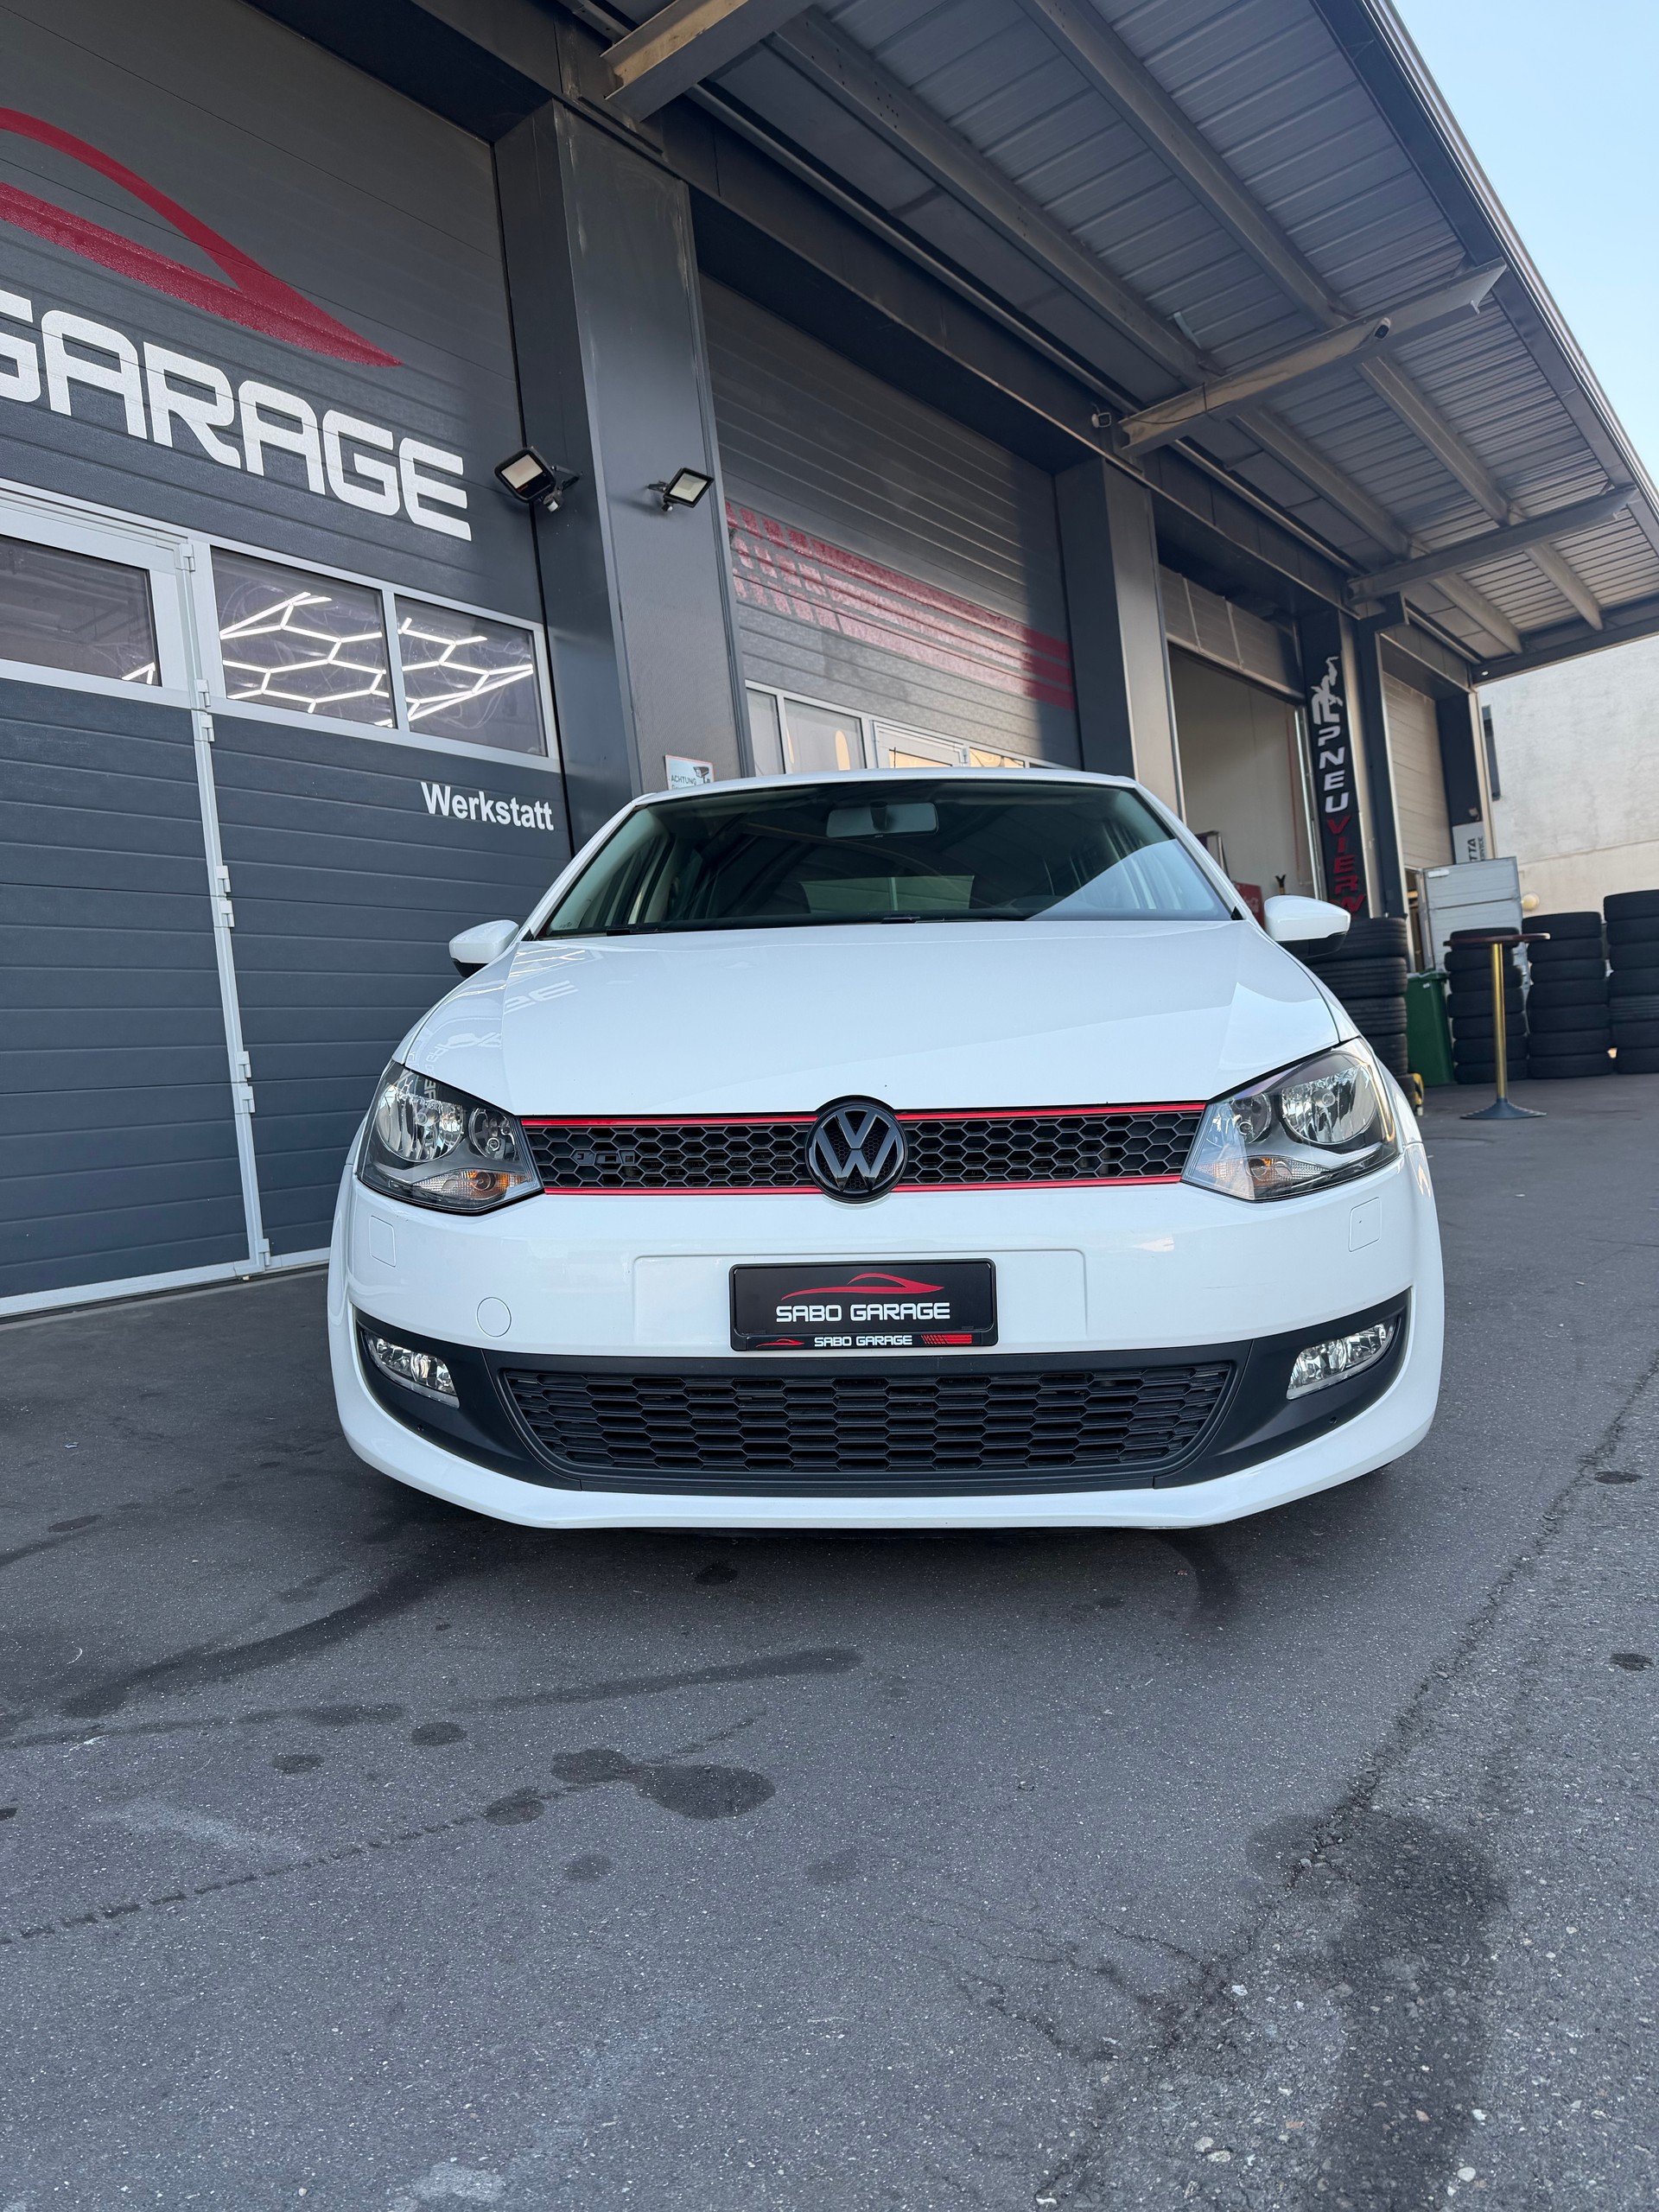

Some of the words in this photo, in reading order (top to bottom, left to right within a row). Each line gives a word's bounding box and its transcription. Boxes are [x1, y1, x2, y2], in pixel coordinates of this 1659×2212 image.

[671, 774, 696, 785] ACHTUNG
[1318, 725, 1349, 814] PNEU
[421, 781, 554, 830] Werkstatt
[776, 1305, 842, 1323] SABO
[849, 1302, 950, 1321] GARAGE
[814, 1336, 851, 1347] SABO
[855, 1335, 912, 1346] GARAGE
